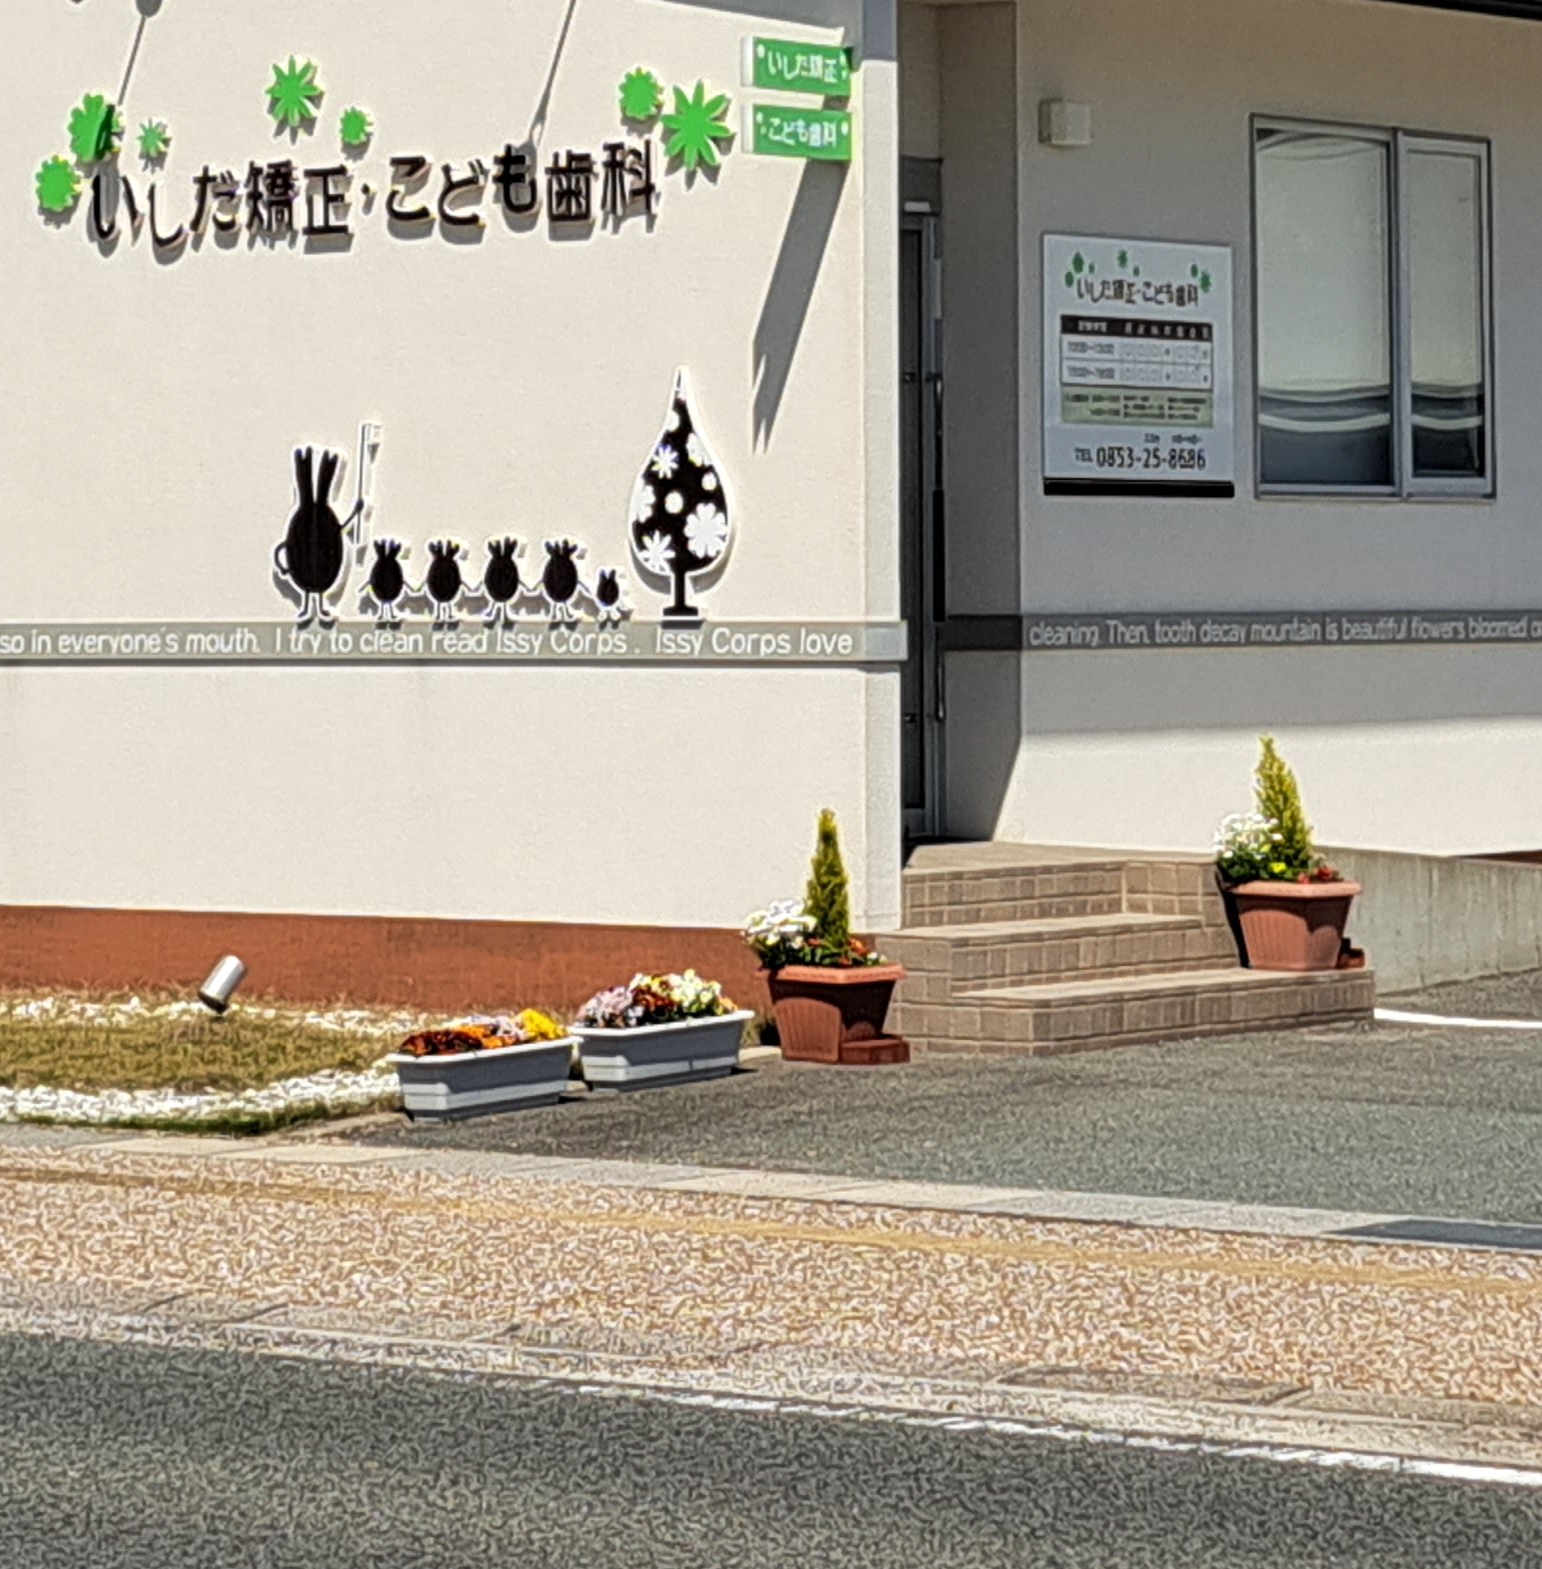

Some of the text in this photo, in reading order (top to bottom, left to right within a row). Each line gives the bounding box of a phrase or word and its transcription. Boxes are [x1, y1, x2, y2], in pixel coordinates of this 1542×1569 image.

[1095, 445, 1207, 470] 0853-25-8686
[30, 629, 52, 654] in
[275, 627, 282, 653] I
[289, 629, 321, 654] try
[330, 629, 353, 654] to
[358, 631, 424, 654] clean
[431, 630, 488, 654] read
[495, 632, 543, 655] Issy
[655, 627, 704, 656] Issy
[711, 627, 792, 655] Corps
[799, 627, 853, 655] love
[1154, 618, 1197, 644] tooth
[1199, 618, 1246, 644] decay
[1250, 617, 1322, 643] mountain
[1325, 617, 1338, 641] is
[1342, 616, 1407, 641] beautiful
